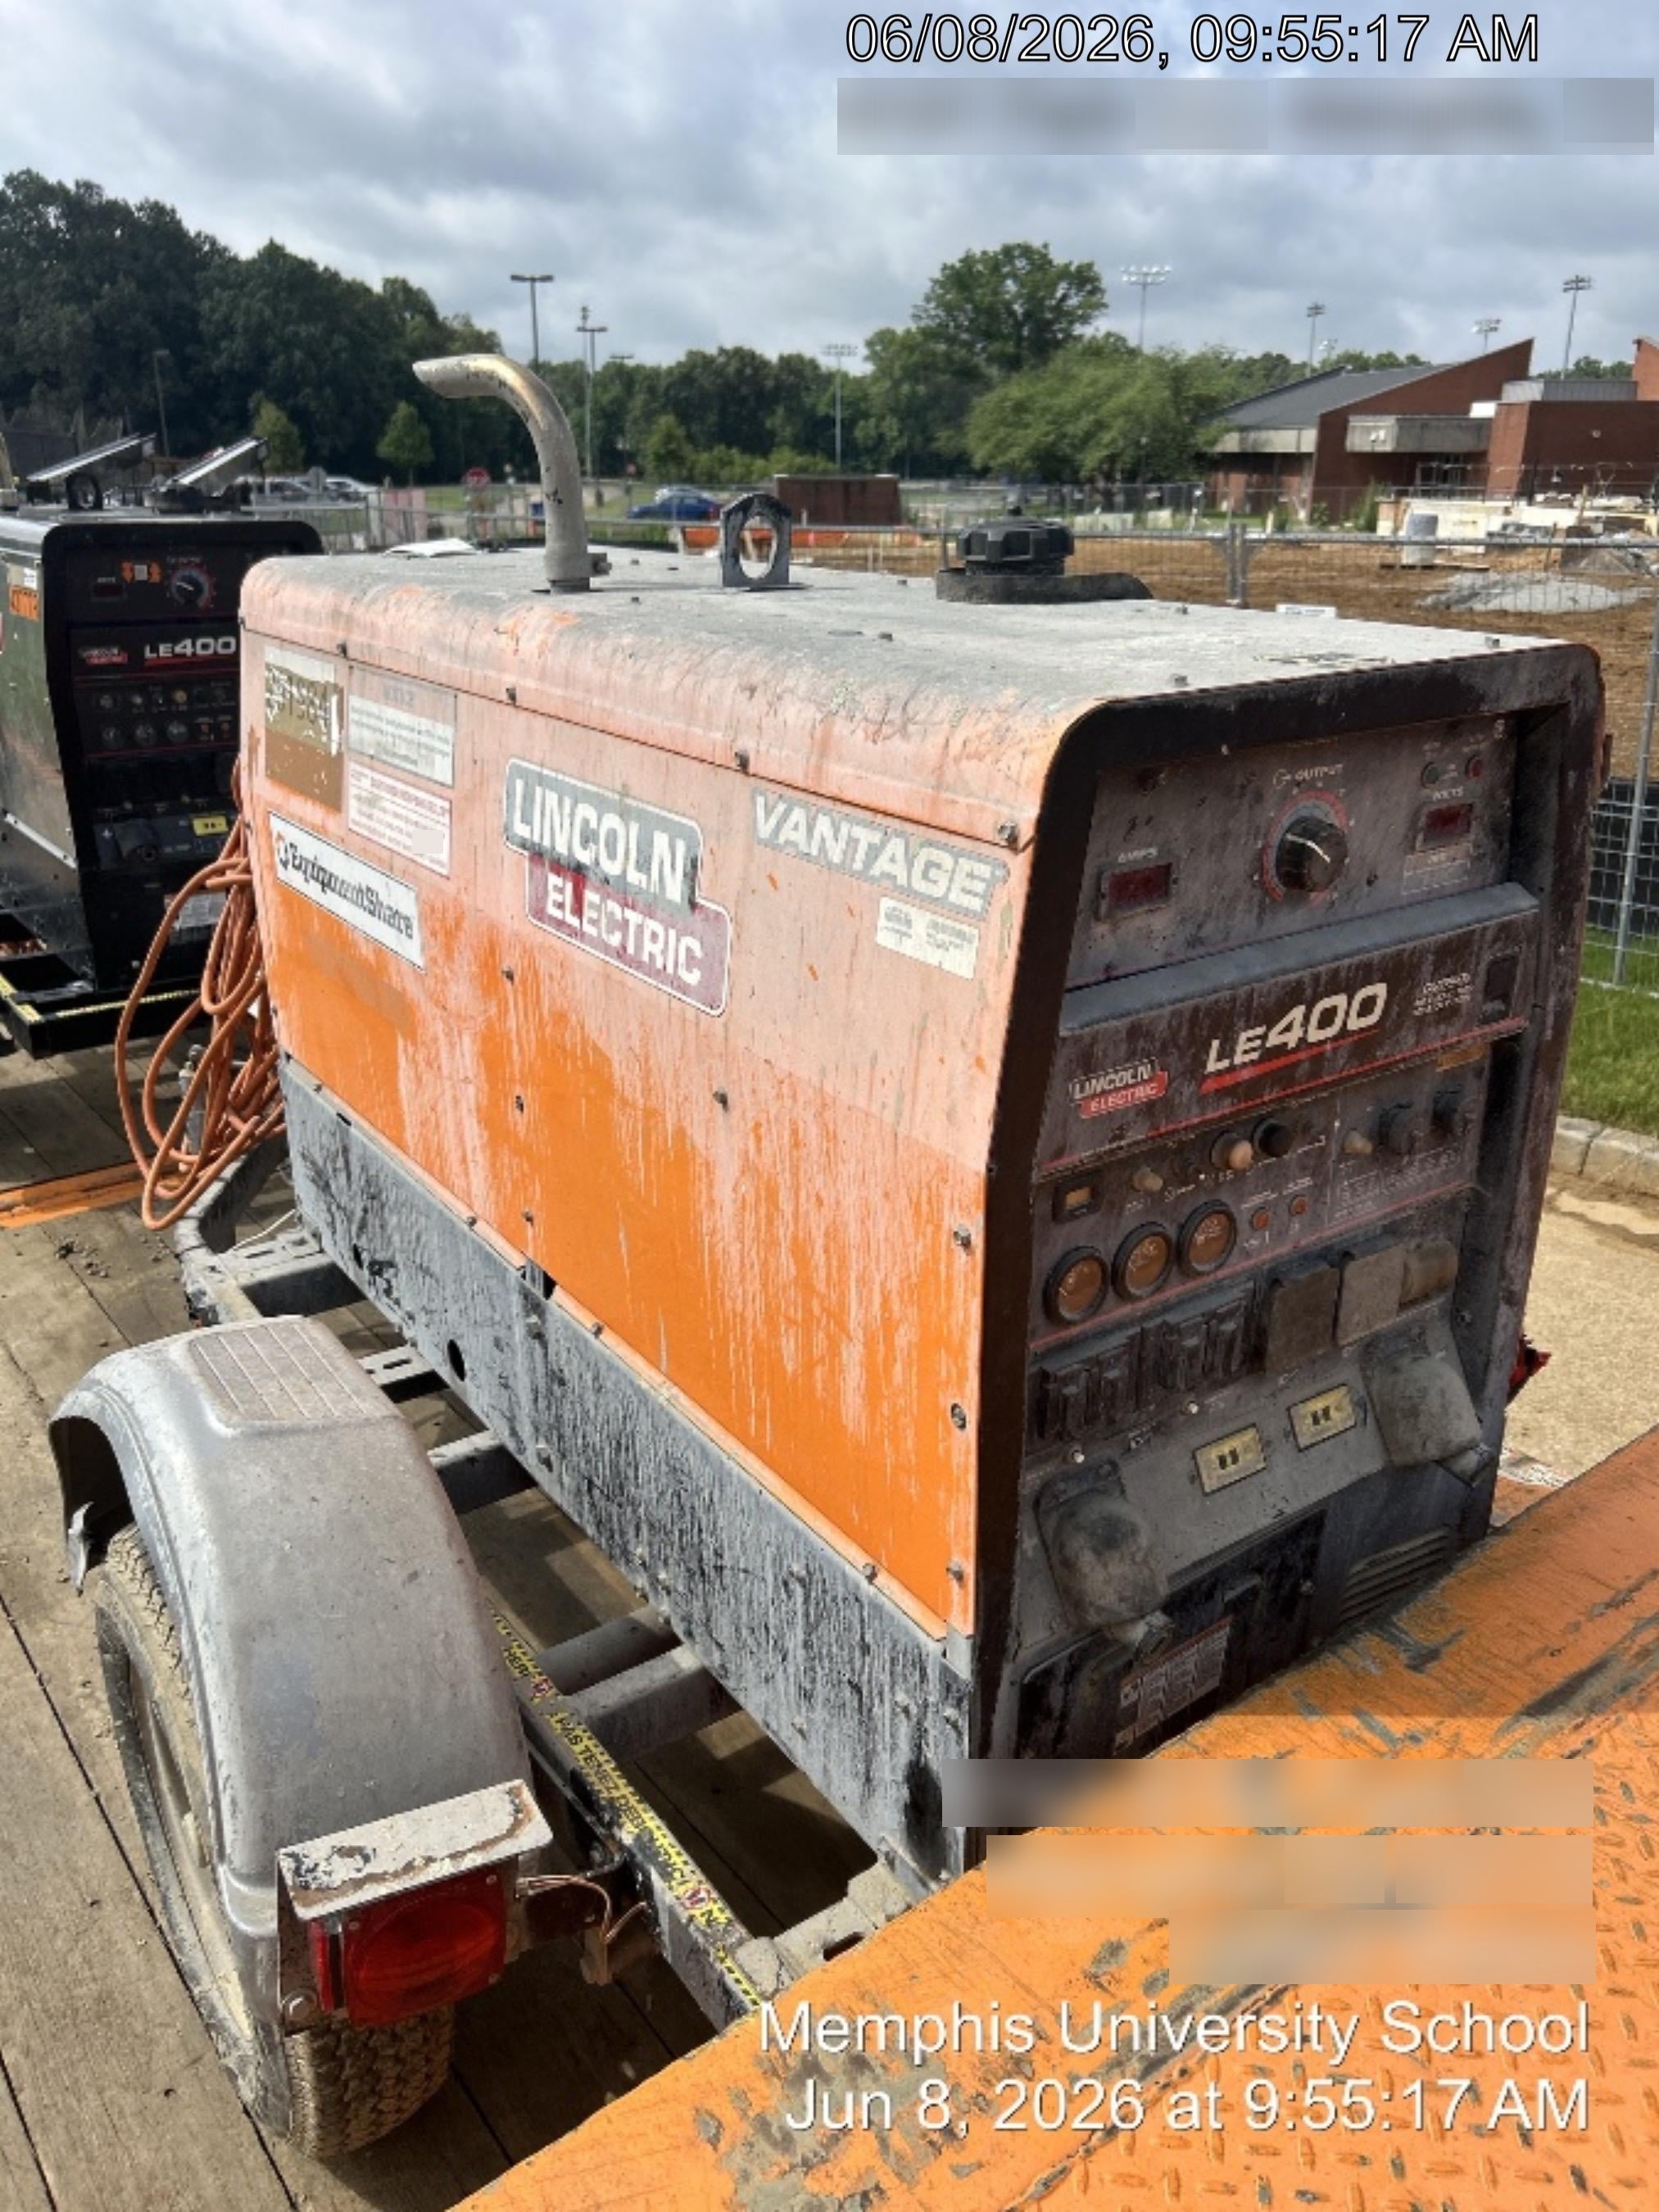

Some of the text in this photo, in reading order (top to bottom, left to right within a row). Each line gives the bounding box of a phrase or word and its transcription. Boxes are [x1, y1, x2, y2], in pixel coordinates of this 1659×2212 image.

[143, 636, 237, 659] LE400
[513, 778, 687, 904] LINCOLN
[755, 795, 994, 913] VANTAGE
[290, 842, 414, 940] EquipmentShare
[546, 872, 702, 986] ELECTRIC
[1203, 983, 1388, 1076] LE400
[1074, 1063, 1152, 1099] LINCOLN
[1090, 1083, 1158, 1112] ELECTRIC
